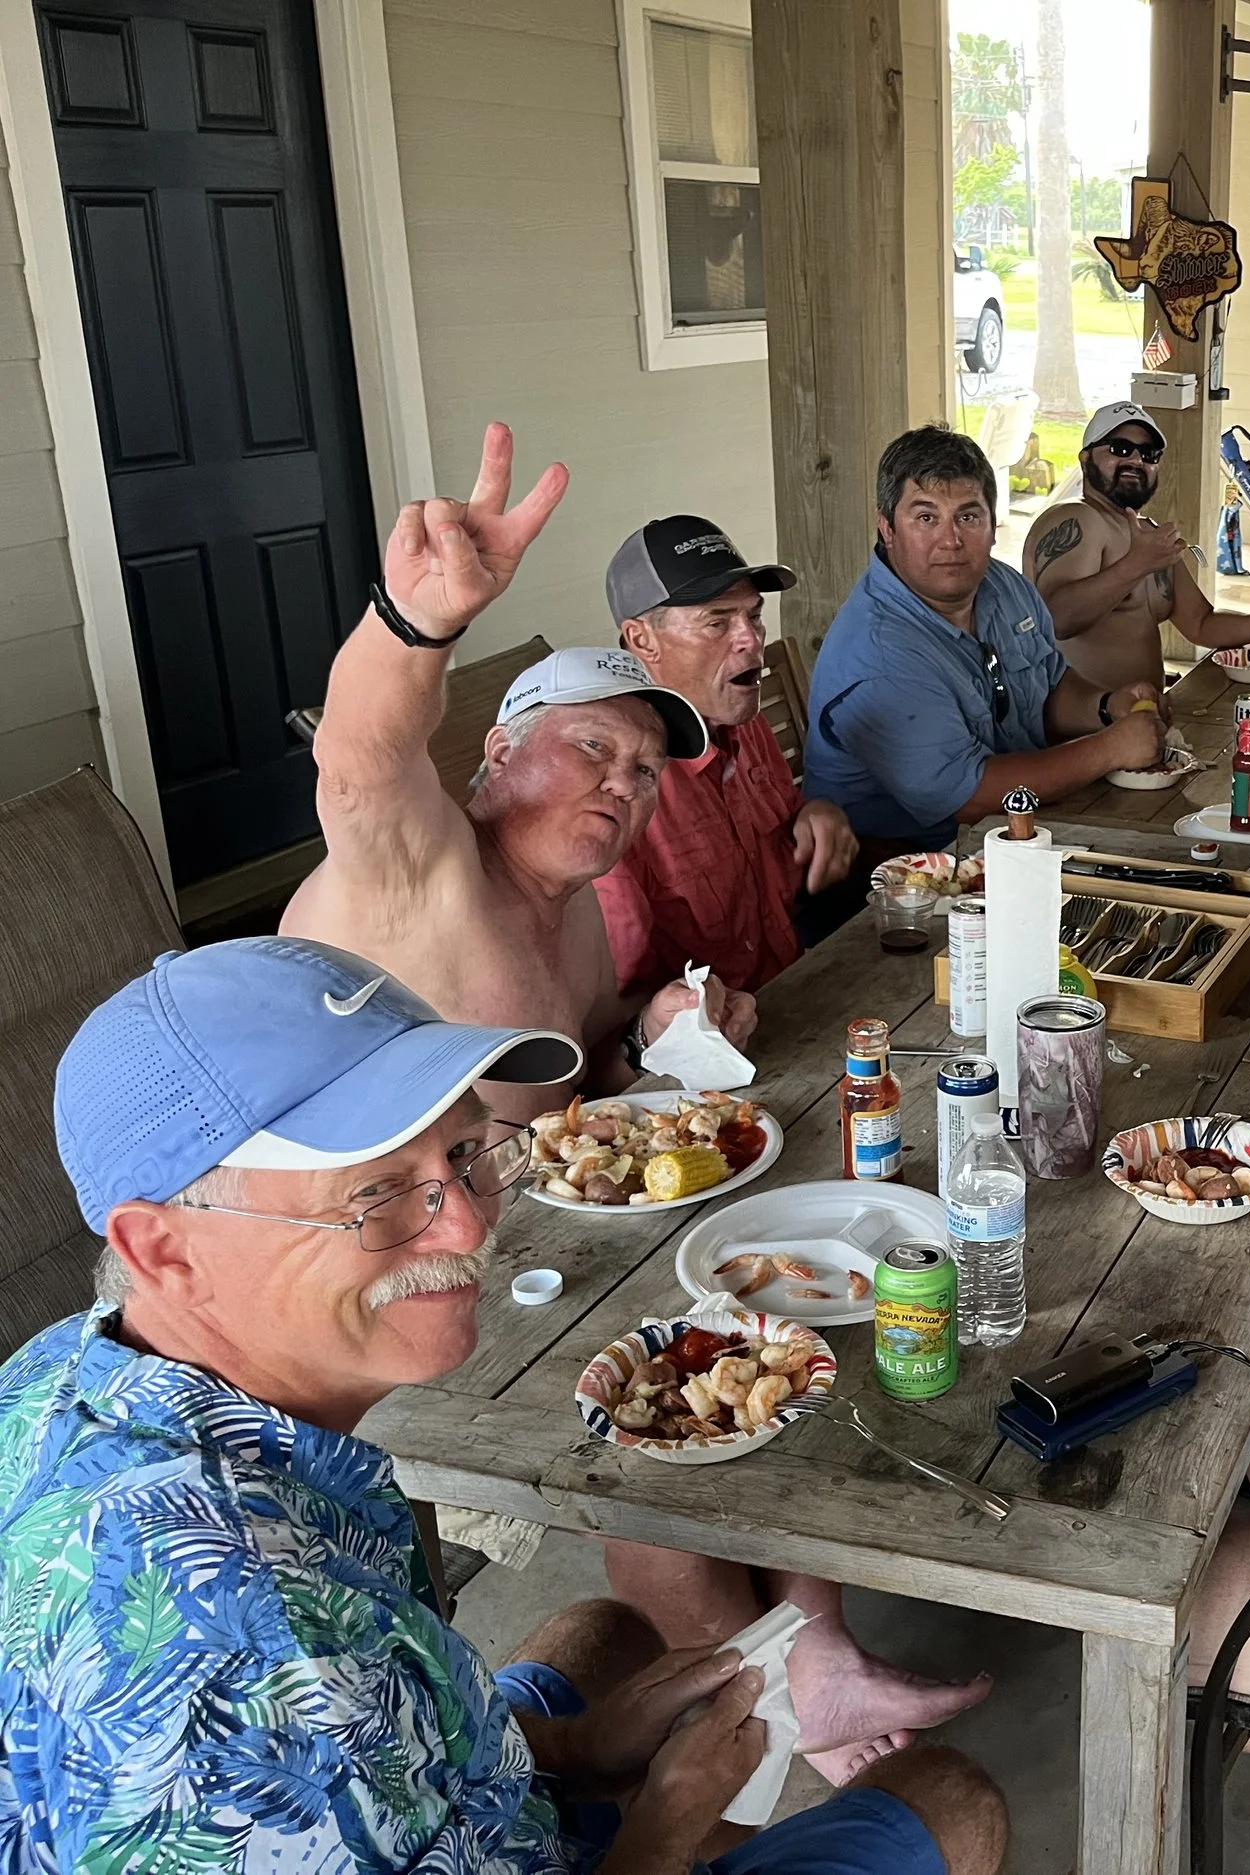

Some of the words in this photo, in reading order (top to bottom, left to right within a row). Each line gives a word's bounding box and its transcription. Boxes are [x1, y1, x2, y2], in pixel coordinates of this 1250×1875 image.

[1157, 252, 1228, 288] Shiner
[901, 1314, 941, 1325] NEVADA
[911, 1356, 946, 1376] ALE
